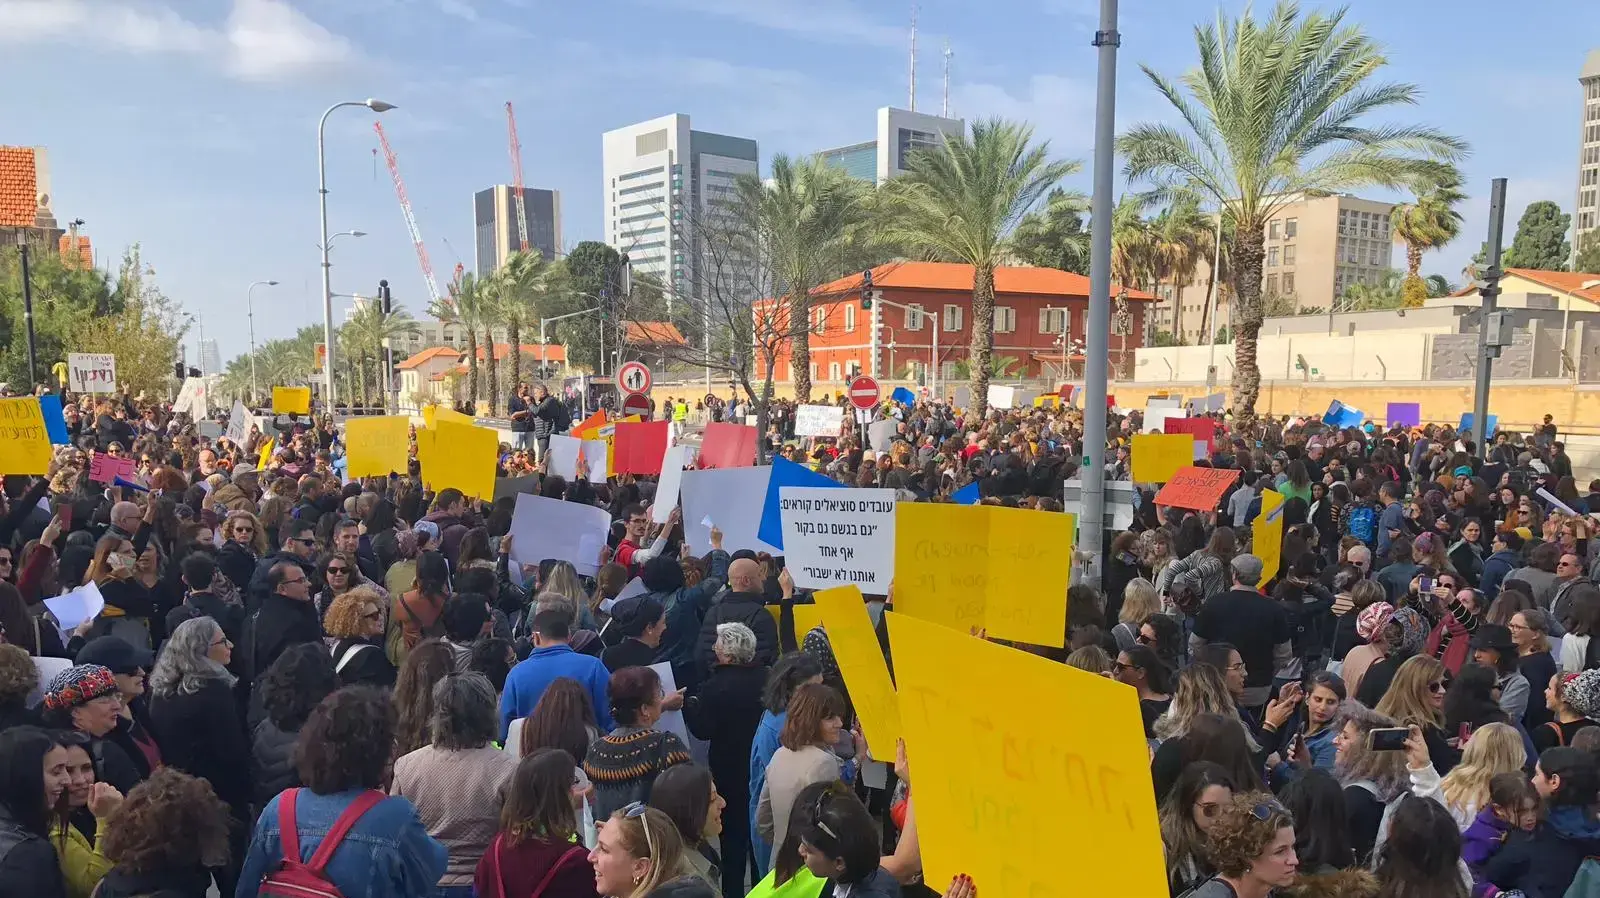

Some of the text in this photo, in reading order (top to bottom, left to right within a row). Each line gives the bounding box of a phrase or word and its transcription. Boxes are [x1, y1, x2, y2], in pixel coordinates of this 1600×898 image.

[780, 498, 893, 514] עובדים סוציאלים קוראים:
[795, 521, 878, 536] "גם בגשם גם בקור
[818, 545, 854, 562] אף אחד
[803, 566, 875, 583] אותנו לא ישבור"
